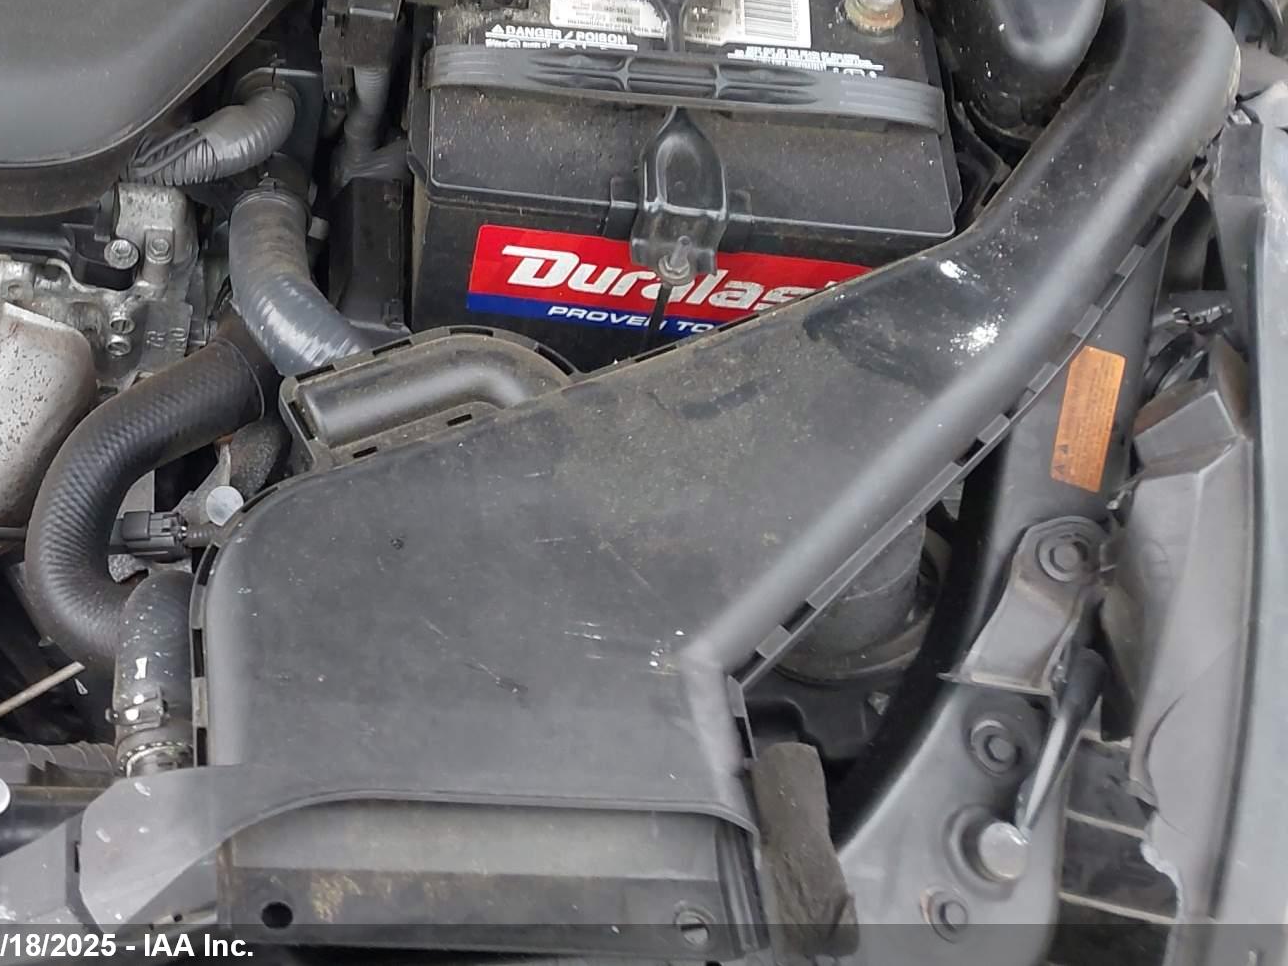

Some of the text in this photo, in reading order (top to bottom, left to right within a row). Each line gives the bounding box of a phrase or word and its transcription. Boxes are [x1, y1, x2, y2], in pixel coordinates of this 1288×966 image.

[505, 25, 561, 40] DANGER
[576, 30, 627, 45] POISON
[502, 245, 836, 310] Duralas
[677, 320, 715, 333] TO
